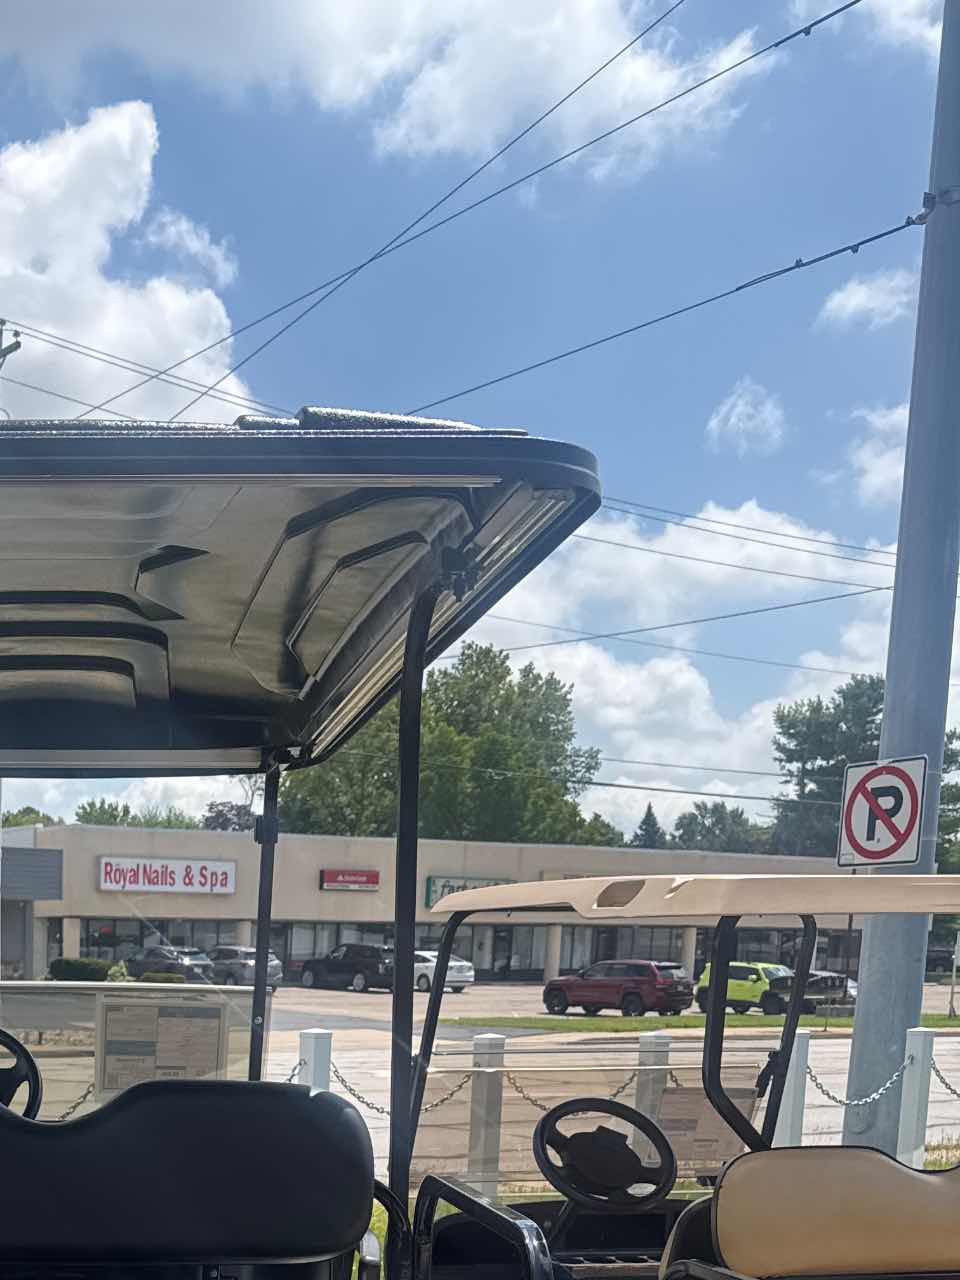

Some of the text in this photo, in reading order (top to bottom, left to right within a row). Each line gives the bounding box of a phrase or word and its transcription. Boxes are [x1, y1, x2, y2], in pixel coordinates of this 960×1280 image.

[103, 861, 229, 892] Royal Nails & Spa
